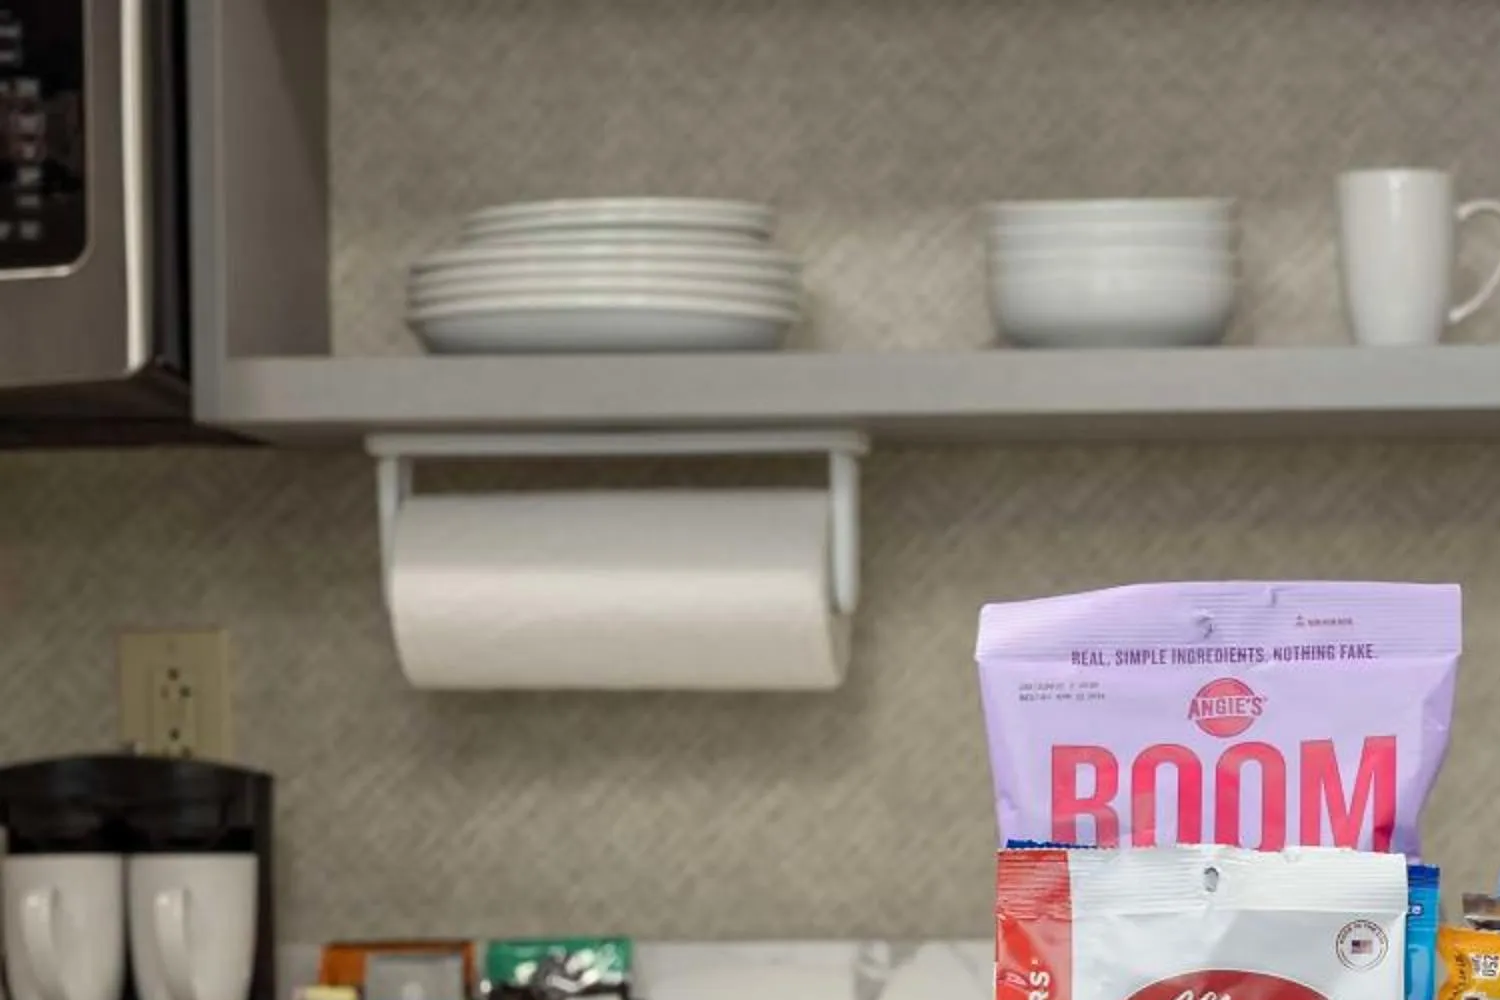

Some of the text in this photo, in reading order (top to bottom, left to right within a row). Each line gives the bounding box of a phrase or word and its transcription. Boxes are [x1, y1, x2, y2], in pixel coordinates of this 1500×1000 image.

[1071, 650, 1111, 668] REAL,
[1115, 649, 1168, 666] SIMPLE
[1273, 645, 1336, 662] NOTHING
[1187, 696, 1264, 722] ANGIE'S
[1051, 735, 1398, 852] BOOM
